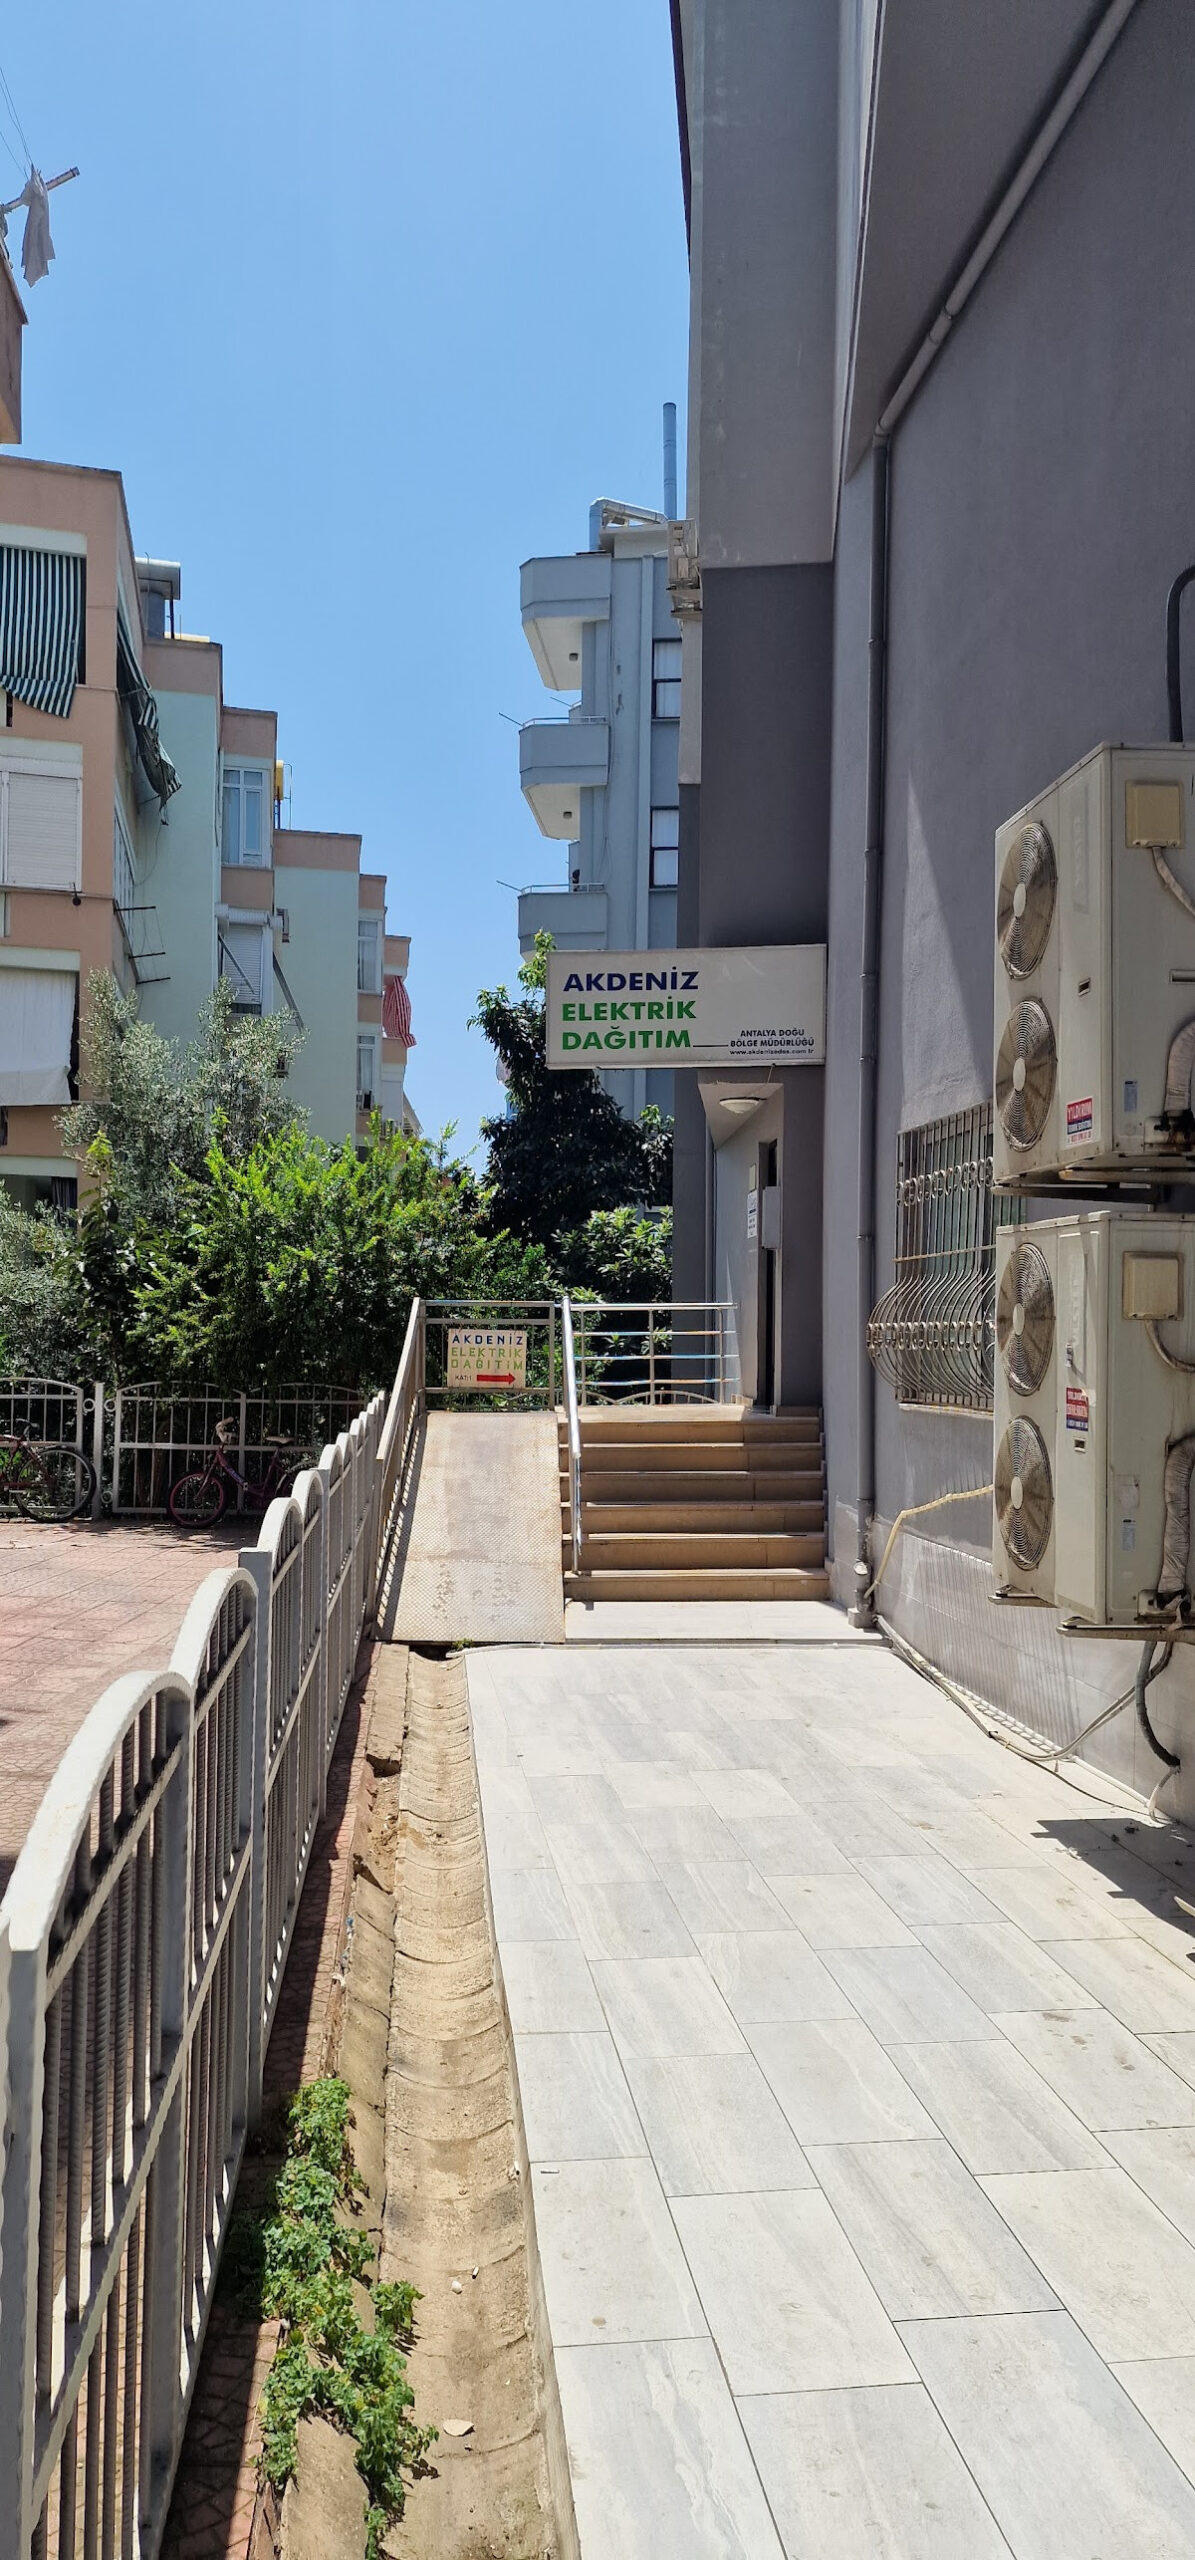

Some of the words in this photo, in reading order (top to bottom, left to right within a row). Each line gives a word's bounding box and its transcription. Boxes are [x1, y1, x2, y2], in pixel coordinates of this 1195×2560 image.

[563, 966, 699, 992] AKDENİZ
[562, 996, 697, 1021] ELEKTRİK
[562, 1025, 691, 1050] DAĞITIM
[740, 1029, 776, 1038] ANTALYA
[779, 1027, 805, 1037] DOĞU
[730, 1038, 758, 1047] BÖLGE
[760, 1037, 815, 1047] MÜDÜRLÜĞÜ
[452, 1333, 523, 1345] AKDENİZ
